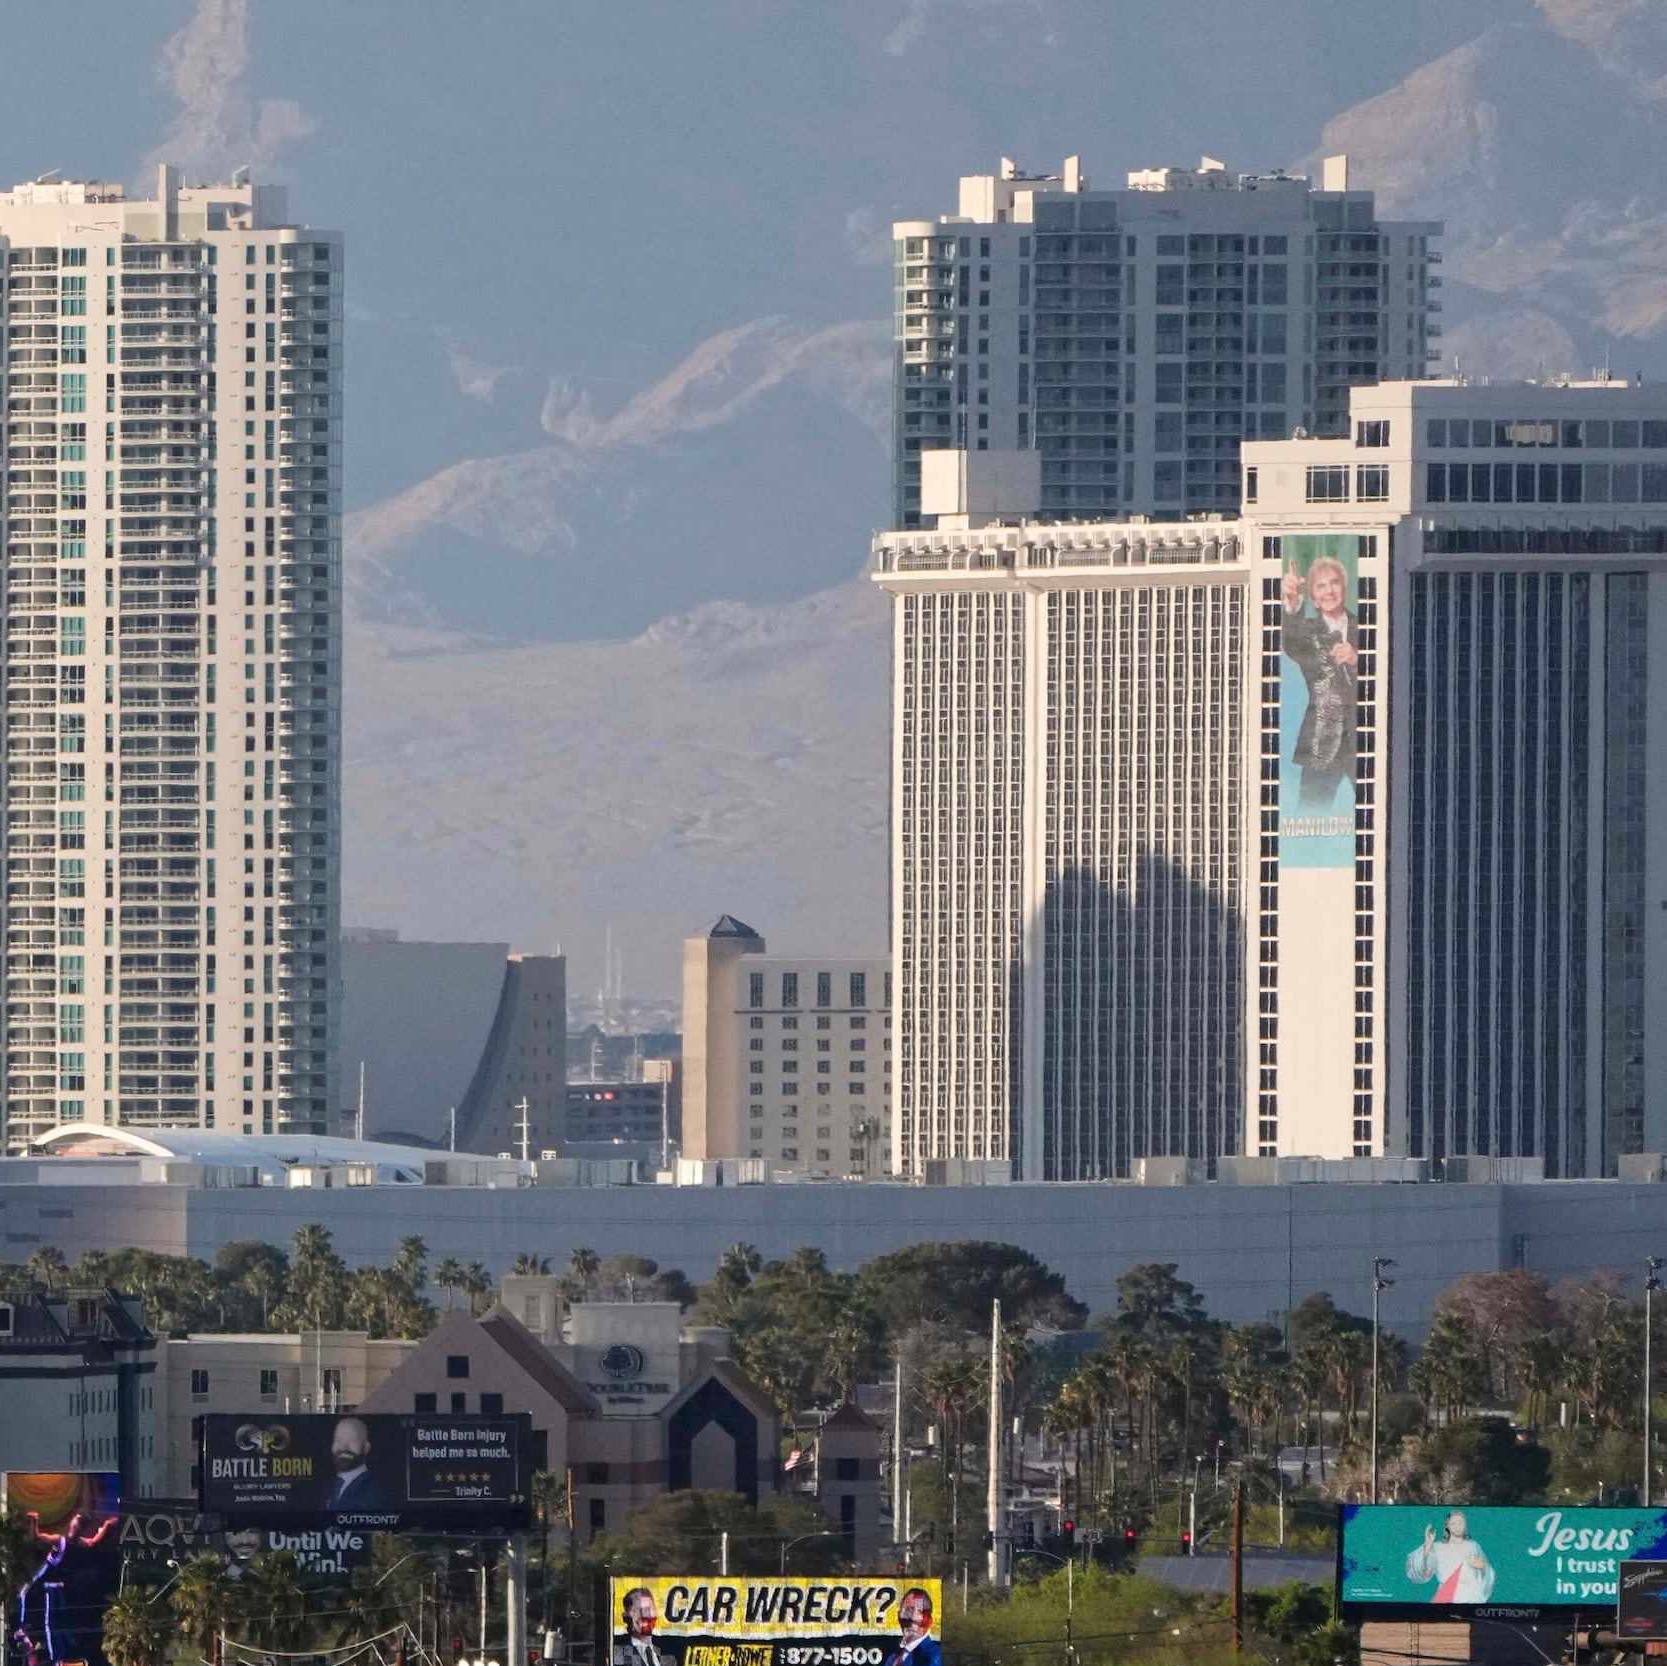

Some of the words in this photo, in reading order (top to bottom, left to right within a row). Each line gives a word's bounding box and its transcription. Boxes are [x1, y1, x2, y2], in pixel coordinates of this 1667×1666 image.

[1282, 816, 1354, 837] MANILOW
[417, 1428, 449, 1441] Battle
[450, 1428, 475, 1441] Born
[476, 1428, 507, 1443] Injury
[412, 1446, 447, 1460] helped
[448, 1448, 464, 1458] me
[466, 1448, 478, 1458] so
[479, 1446, 511, 1458] much.
[212, 1459, 268, 1478] BATTLE
[272, 1457, 312, 1477] BORN
[454, 1486, 481, 1498] Trinity
[483, 1486, 492, 1496] C.
[268, 1530, 320, 1550] Until
[325, 1531, 364, 1550] We
[1528, 1511, 1634, 1557] Jesus
[1567, 1557, 1616, 1573] trust
[1556, 1578, 1576, 1594] in
[1578, 1582, 1617, 1598] you
[665, 1586, 738, 1623] CAR
[745, 1585, 897, 1623] WRECK?
[787, 1646, 883, 1666] 877-1500
